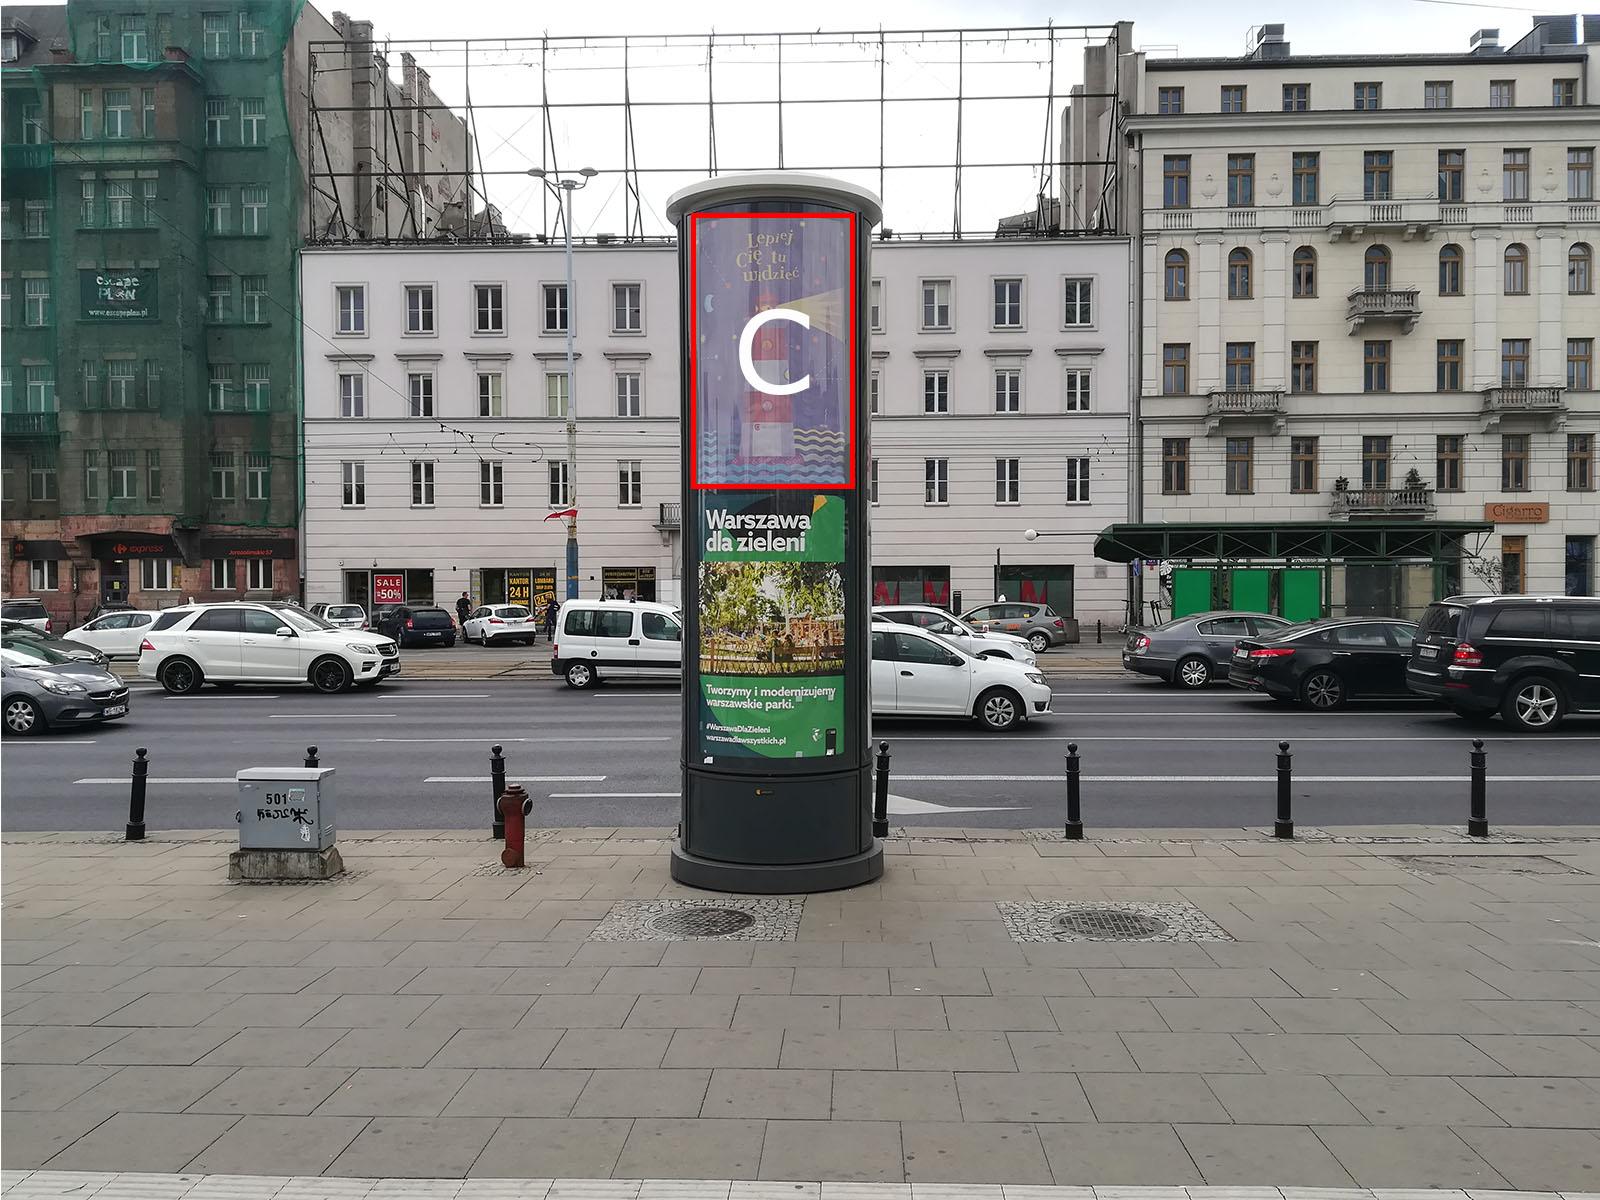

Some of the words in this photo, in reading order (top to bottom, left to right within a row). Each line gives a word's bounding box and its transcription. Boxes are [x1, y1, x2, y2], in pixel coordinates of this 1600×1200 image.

[747, 229, 793, 249] Lepiej
[736, 249, 762, 268] Cię
[771, 251, 786, 264] tu
[743, 264, 799, 282] widzieć
[1493, 504, 1543, 518] Cigarro
[705, 509, 811, 530] Warszawa
[706, 530, 733, 552] dla
[736, 530, 806, 552] zieleni
[510, 587, 521, 597] 24
[523, 587, 529, 597] H
[706, 684, 752, 700] Tworzymy
[754, 686, 758, 696] i
[760, 687, 836, 698] modernizujemy
[706, 698, 763, 709] warszawskie
[765, 698, 795, 711] parki.
[705, 723, 771, 734] #WarszawaDlaZieleni
[266, 793, 287, 805] 501
